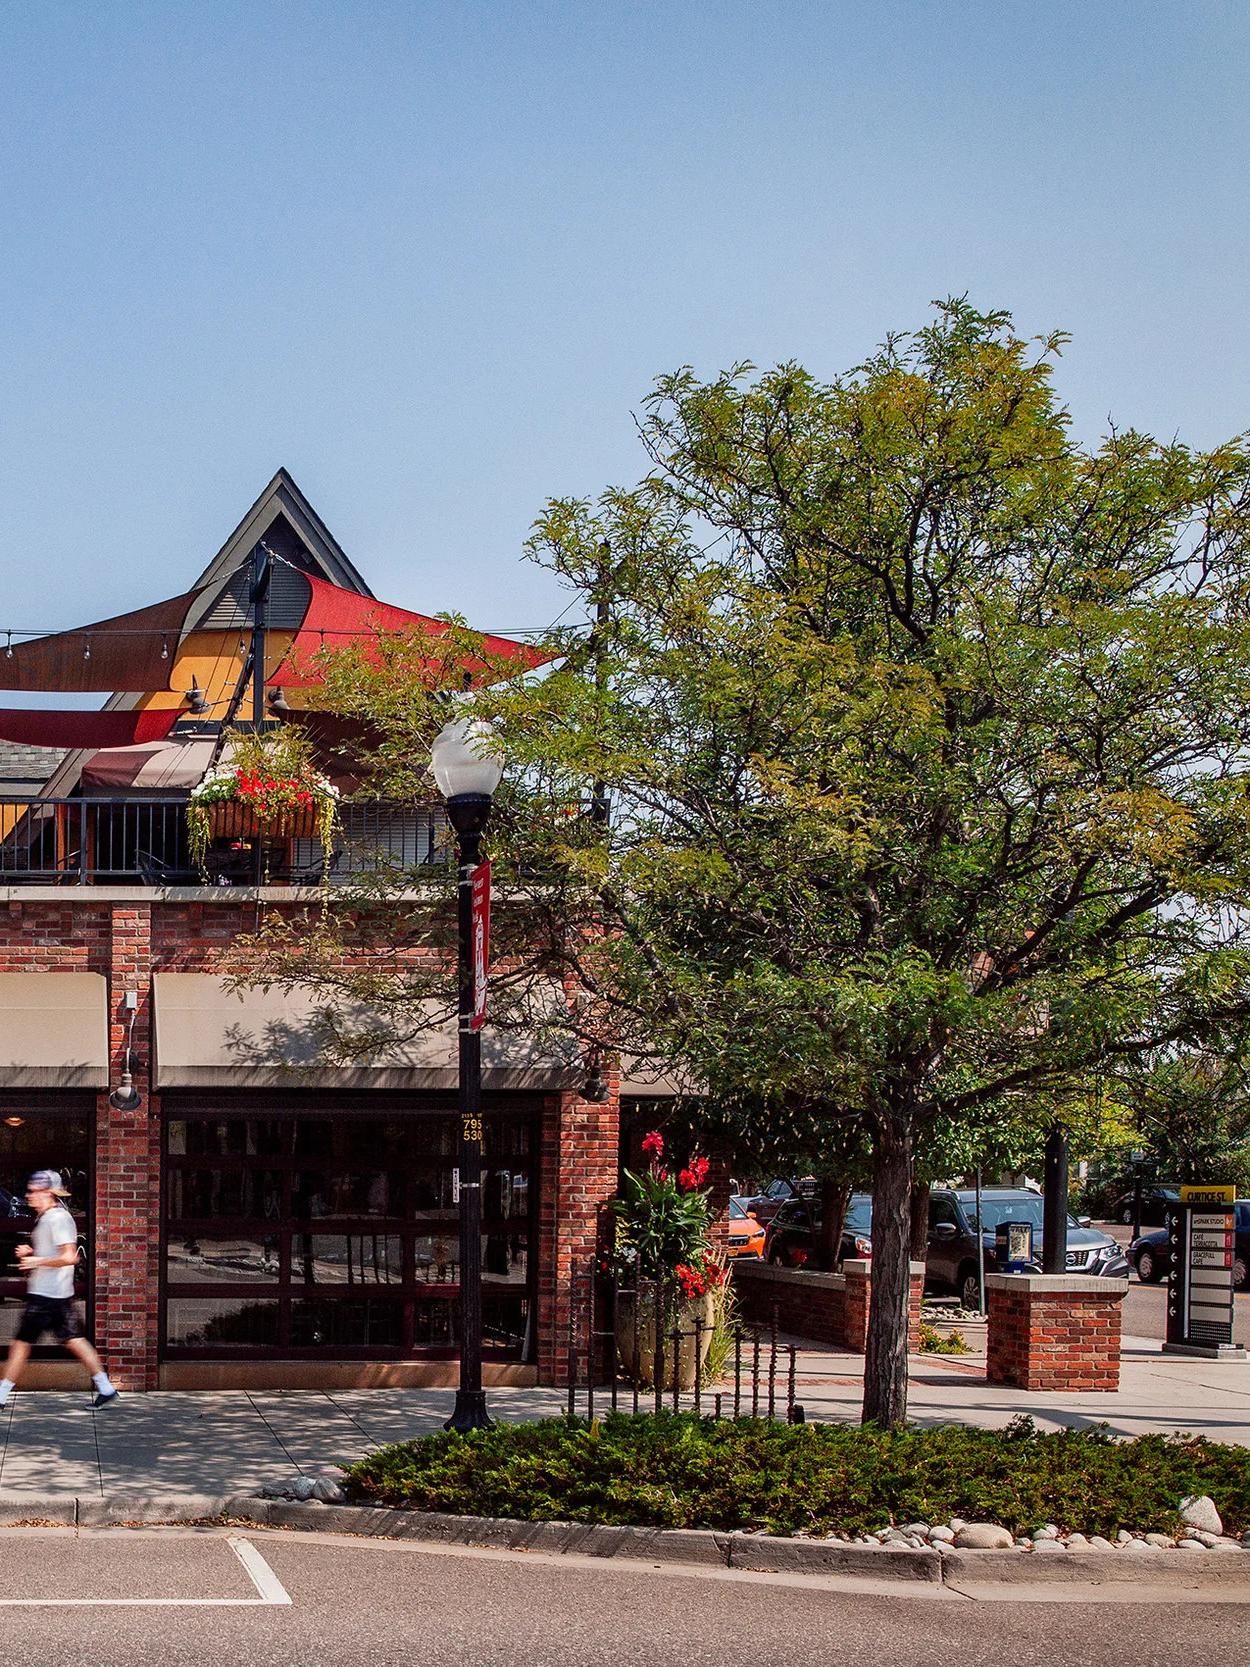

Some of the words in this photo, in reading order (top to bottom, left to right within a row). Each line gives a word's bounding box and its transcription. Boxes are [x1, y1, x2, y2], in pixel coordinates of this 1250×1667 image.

[463, 1119, 482, 1129] 795
[463, 1130, 482, 1141] 530
[1187, 1192, 1215, 1202] CURTICE
